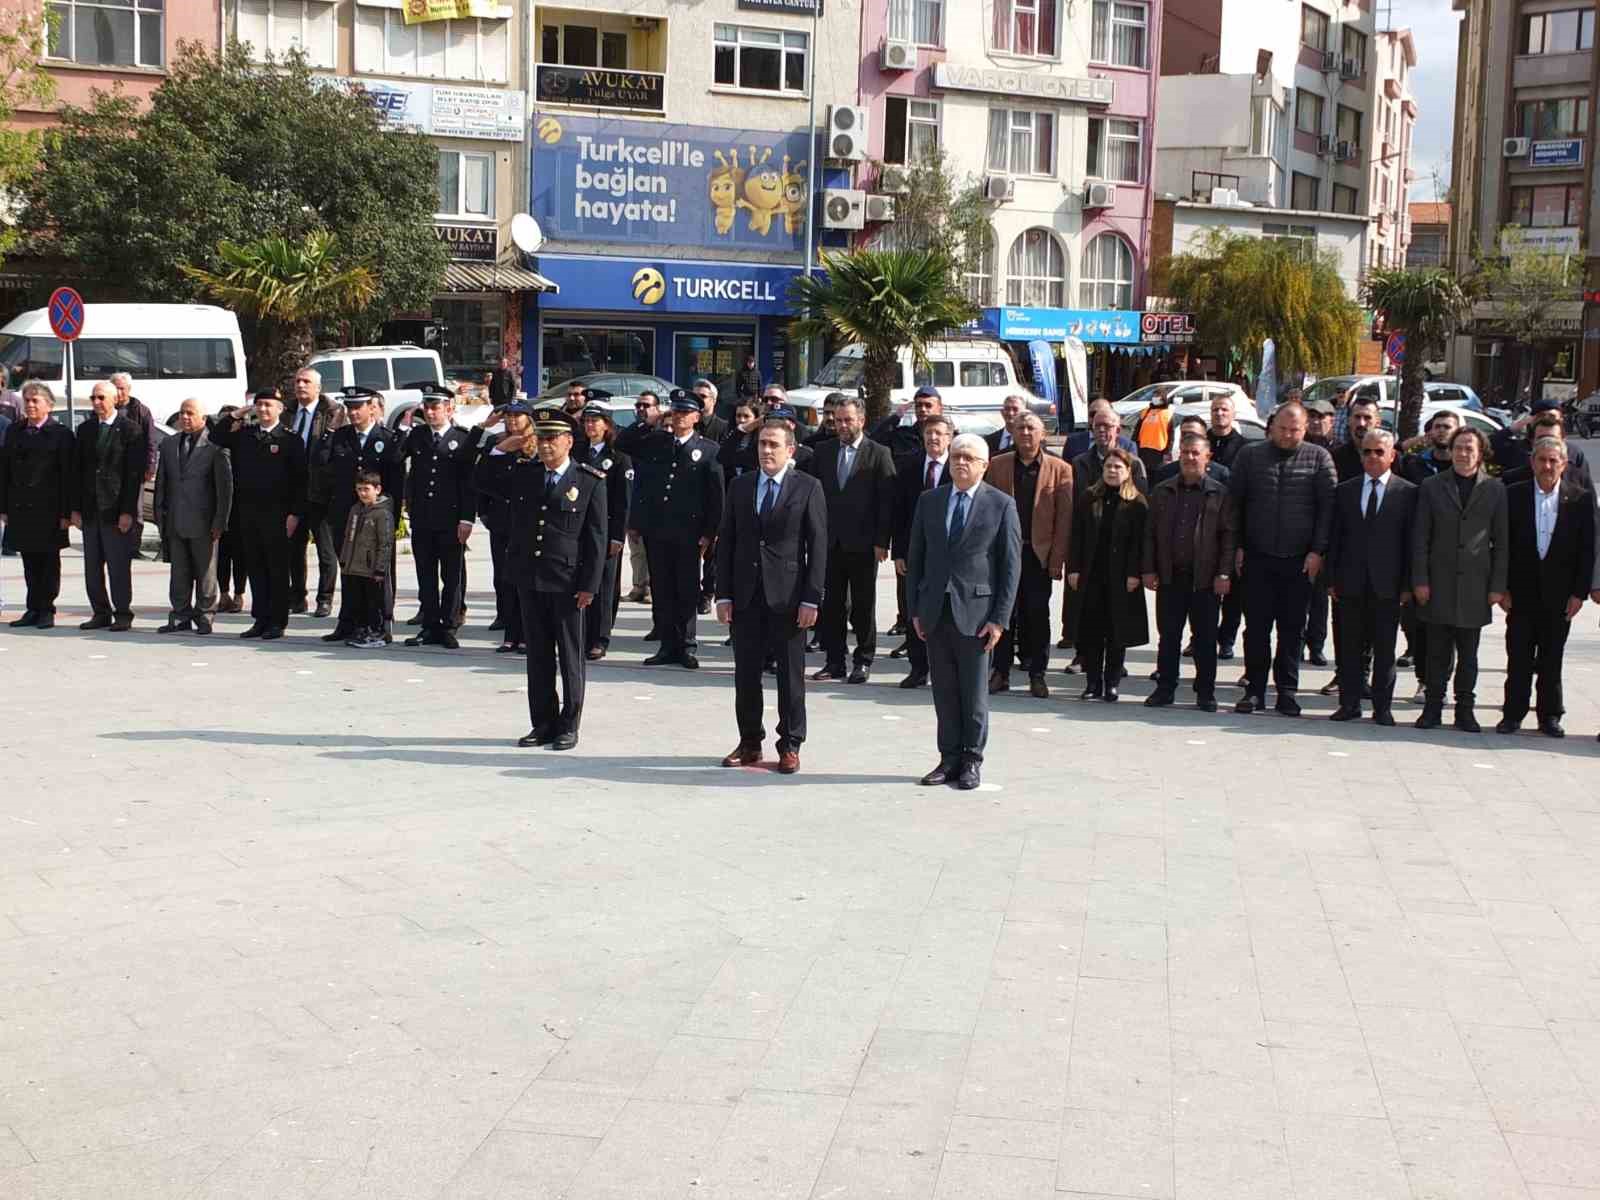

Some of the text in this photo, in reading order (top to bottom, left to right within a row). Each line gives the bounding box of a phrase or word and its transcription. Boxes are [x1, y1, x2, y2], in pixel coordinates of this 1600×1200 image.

[579, 71, 661, 90] AVUKAT
[1040, 79, 1106, 100] OTEL
[576, 164, 667, 197] bağlan
[575, 193, 676, 225] hayata!
[673, 277, 776, 300] TURKCELL
[1142, 313, 1195, 334] OTEL
